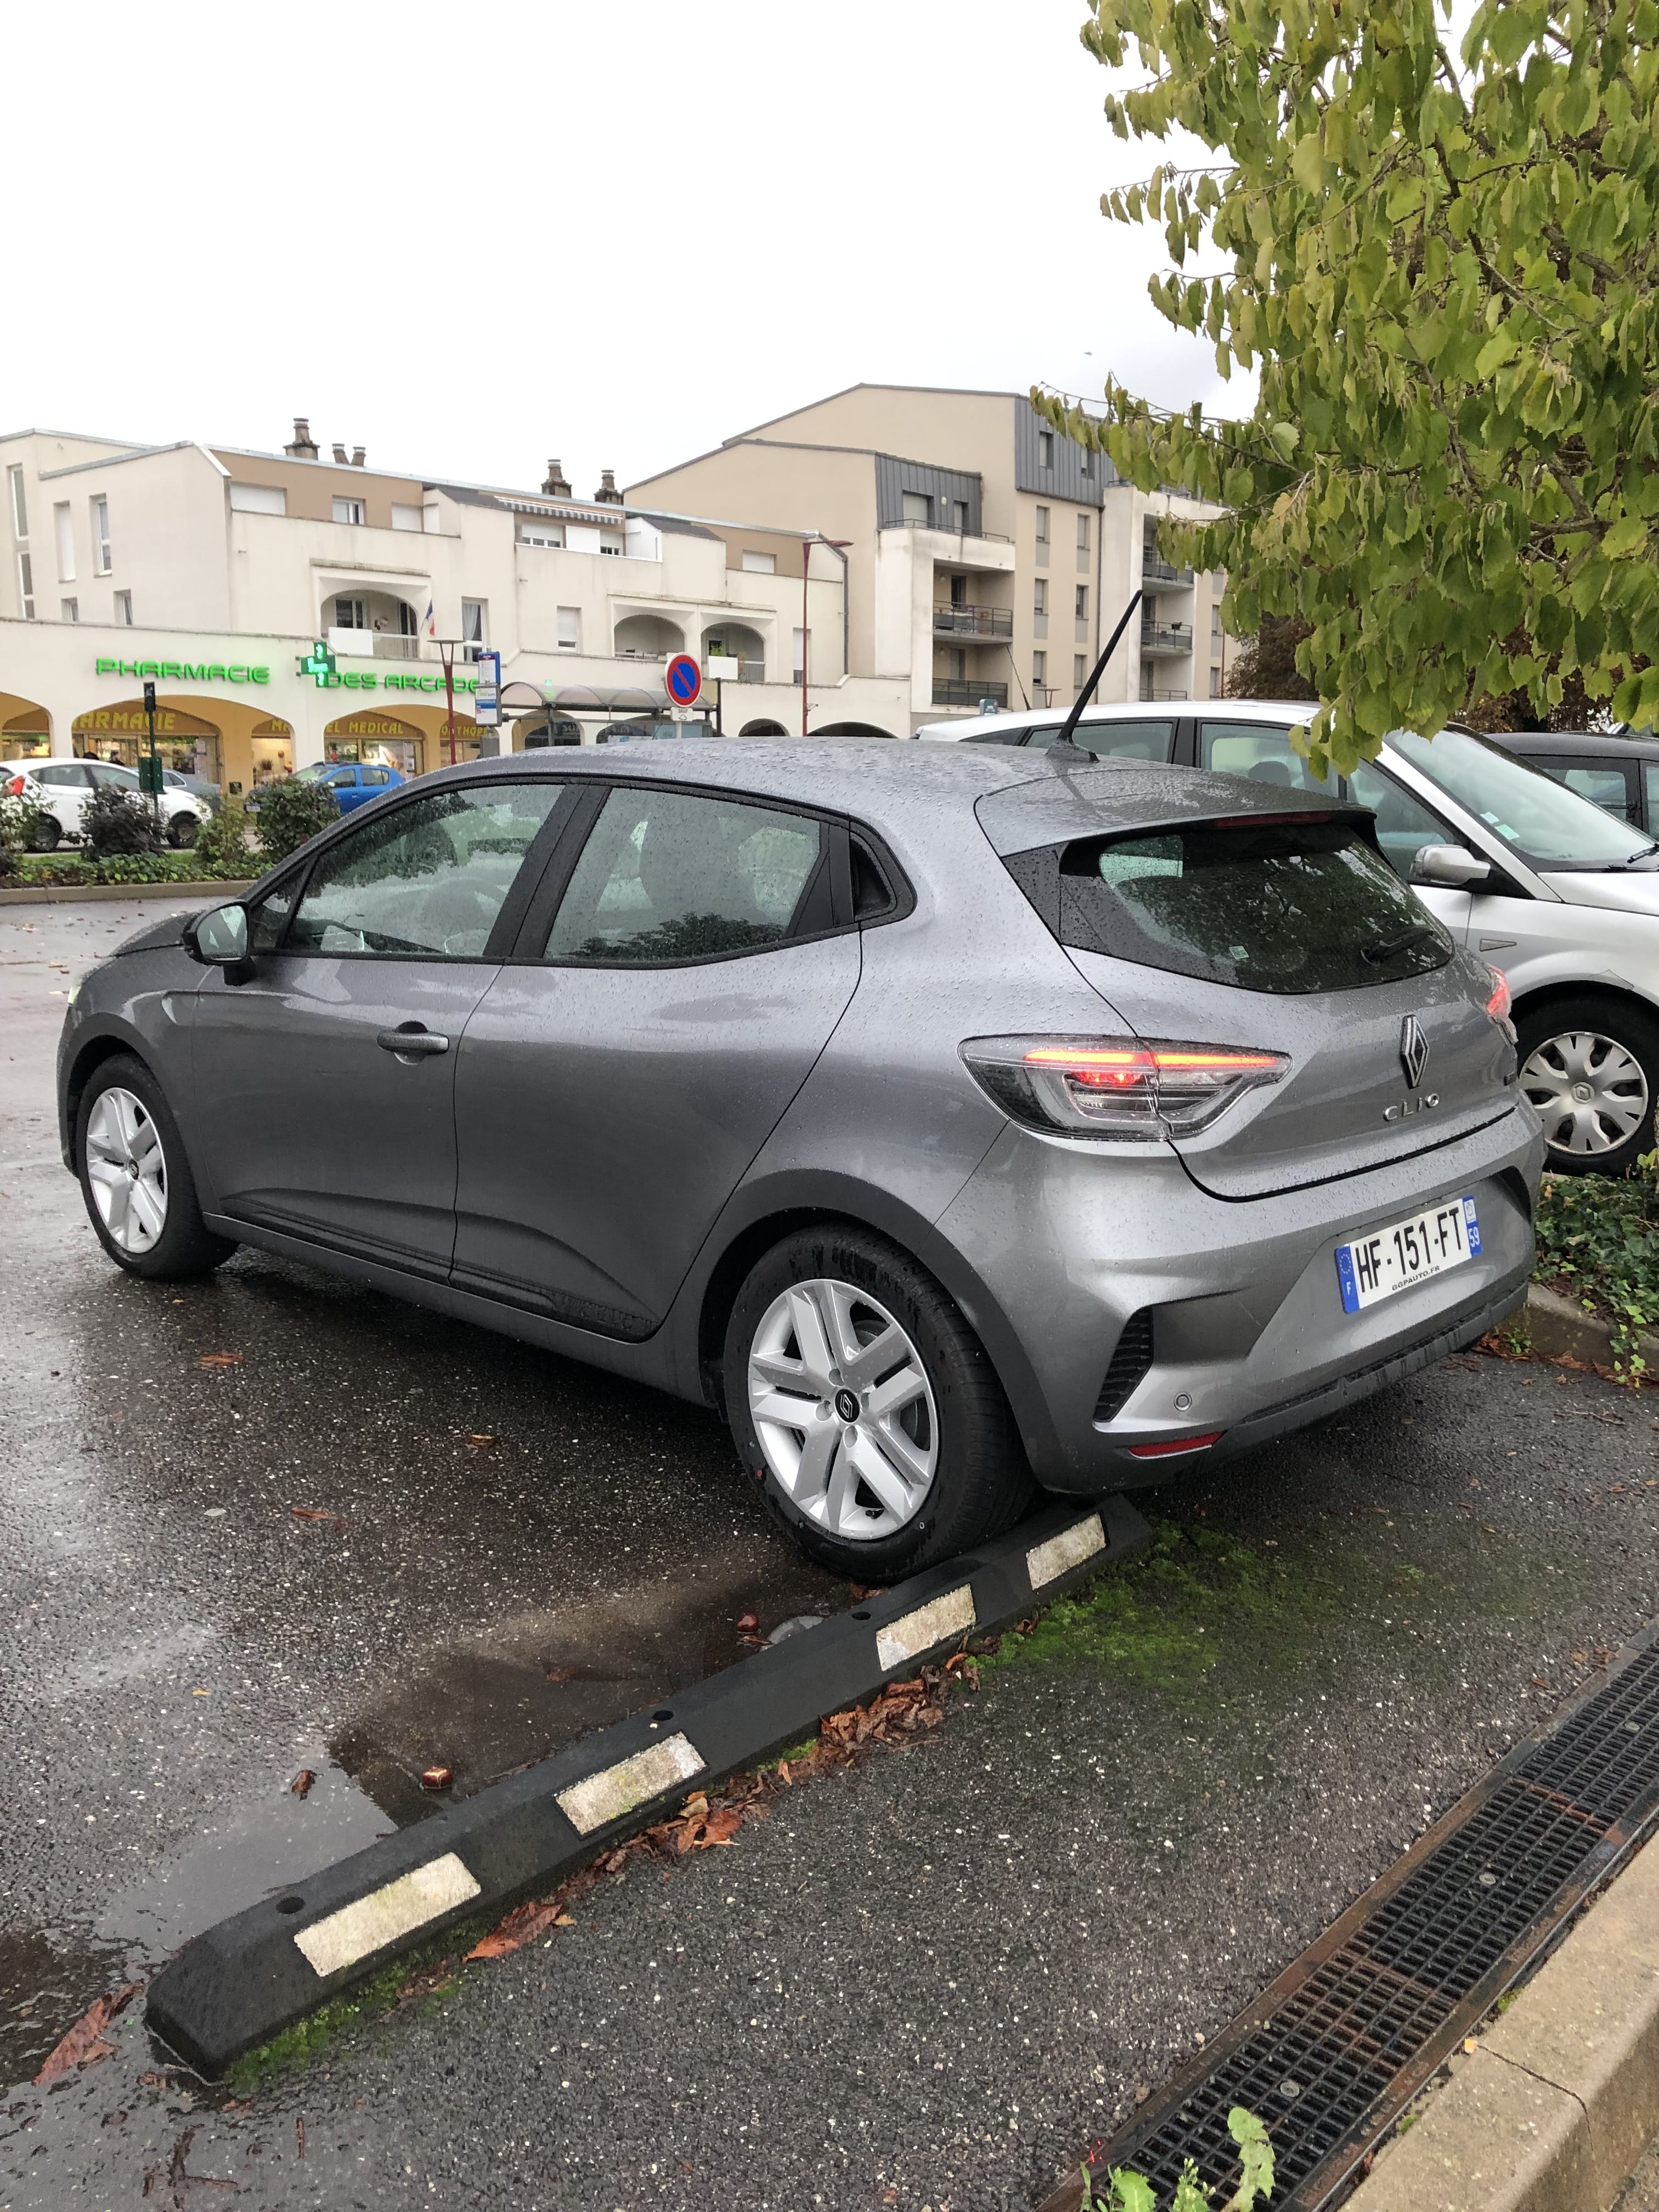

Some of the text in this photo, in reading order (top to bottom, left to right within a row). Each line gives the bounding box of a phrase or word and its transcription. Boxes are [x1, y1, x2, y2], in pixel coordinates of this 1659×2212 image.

[97, 658, 269, 683] PHARMACIE
[329, 672, 377, 689] DES
[348, 721, 404, 735] MEDICAL
[1383, 1093, 1440, 1121] CLIO
[1468, 1226, 1480, 1248] 59
[1355, 1206, 1462, 1293] HF-151-FT
[1346, 1281, 1351, 1295] F
[1392, 1265, 1441, 1291] GGPAUTO.FR
